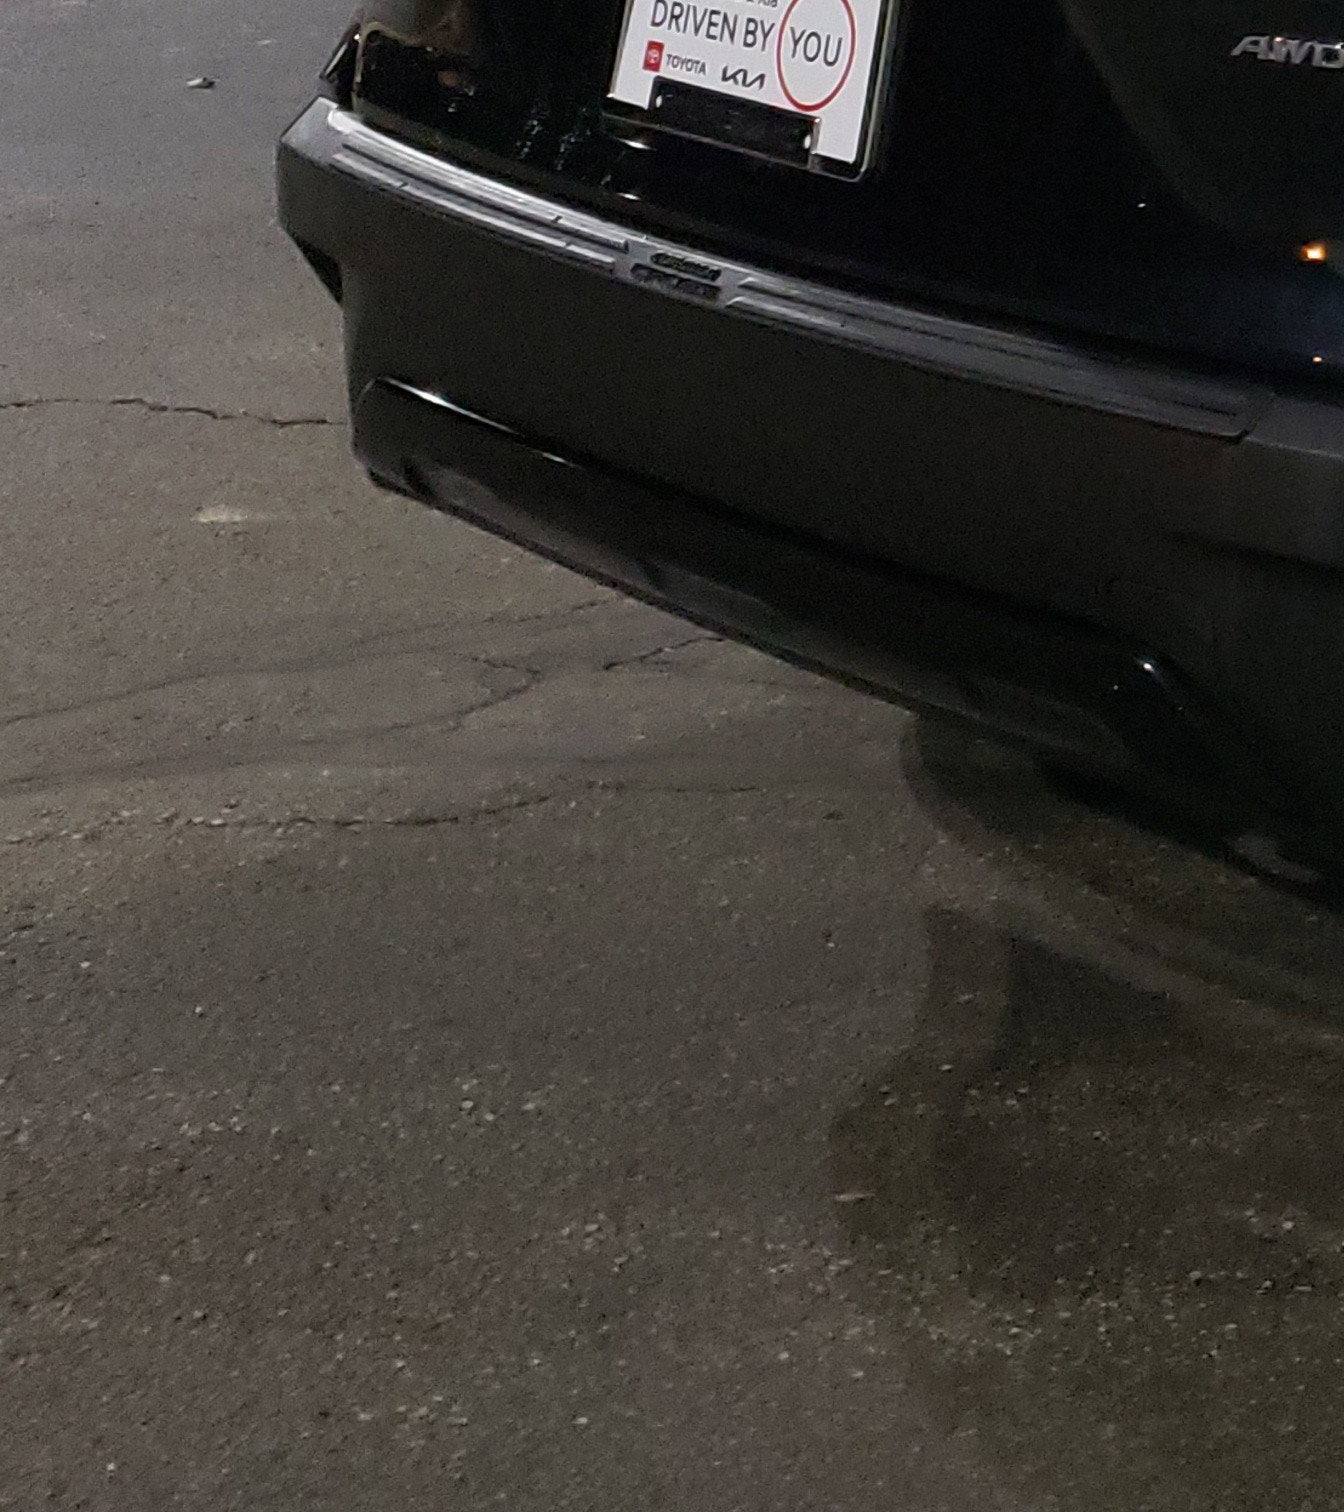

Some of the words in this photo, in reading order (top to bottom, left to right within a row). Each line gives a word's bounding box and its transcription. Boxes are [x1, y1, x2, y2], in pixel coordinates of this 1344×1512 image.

[743, 17, 776, 52] BY
[788, 25, 844, 67] YOU
[666, 53, 706, 75] TOYOTA
